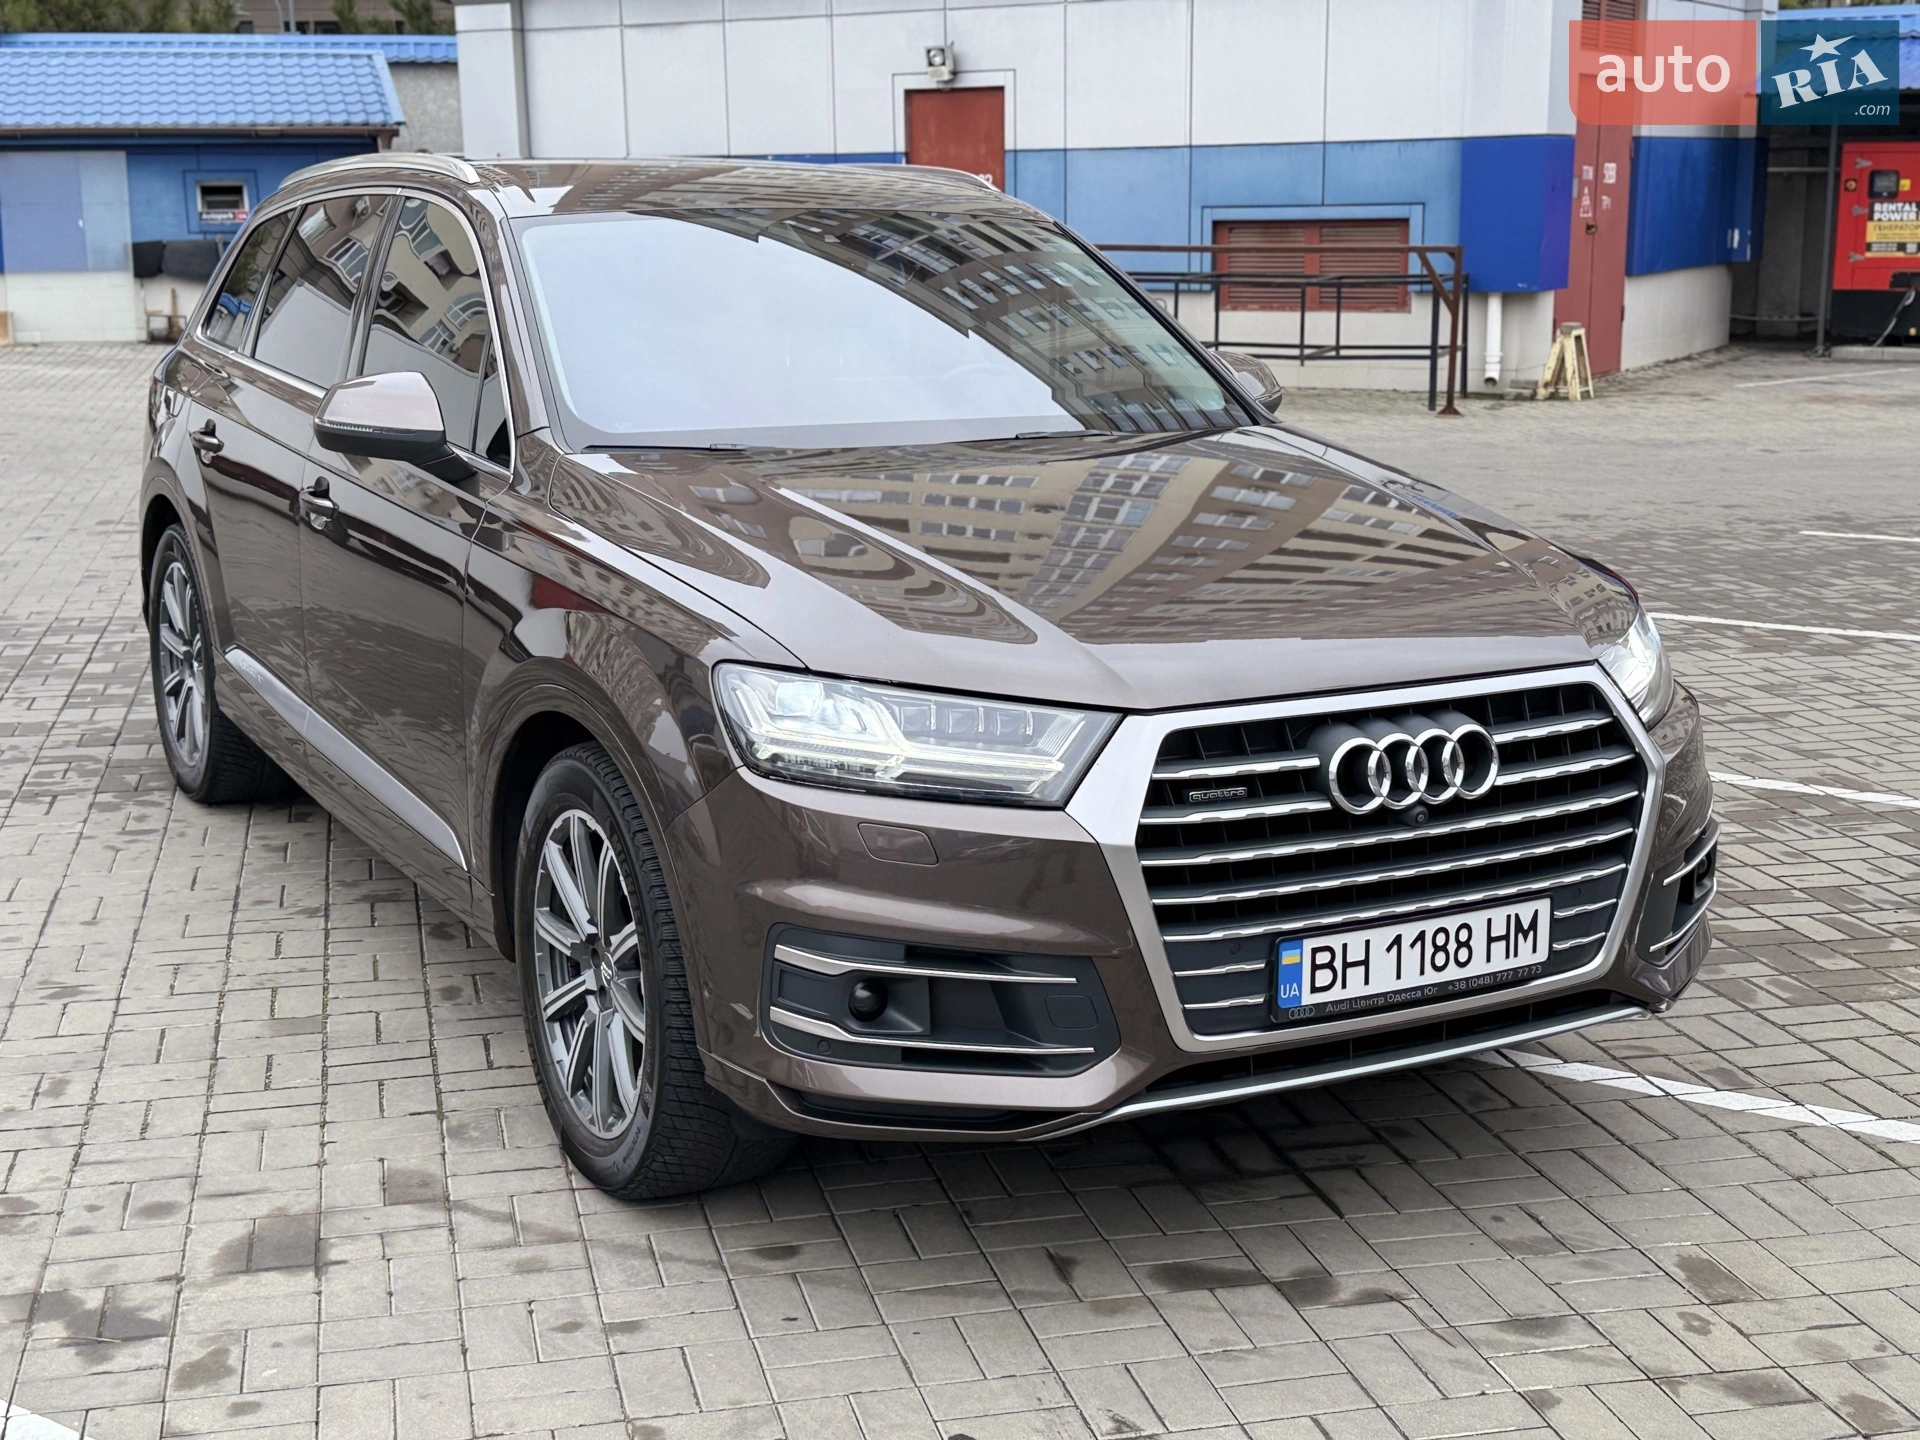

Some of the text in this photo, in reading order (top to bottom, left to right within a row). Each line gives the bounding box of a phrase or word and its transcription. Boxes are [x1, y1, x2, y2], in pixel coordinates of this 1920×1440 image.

[1874, 202, 1918, 212] RENTAL
[1873, 212, 1916, 221] POWER
[1192, 789, 1246, 800] quattro
[1310, 909, 1539, 994] BH 1188 HM
[1280, 983, 1300, 999] UA
[1326, 1000, 1350, 1012] Audi
[1352, 997, 1385, 1008] Центр
[1387, 990, 1421, 1003] Одесса
[1424, 986, 1438, 996] Юг
[1447, 980, 1466, 991] +38
[1468, 975, 1493, 988] (048)
[1496, 971, 1513, 982] 777
